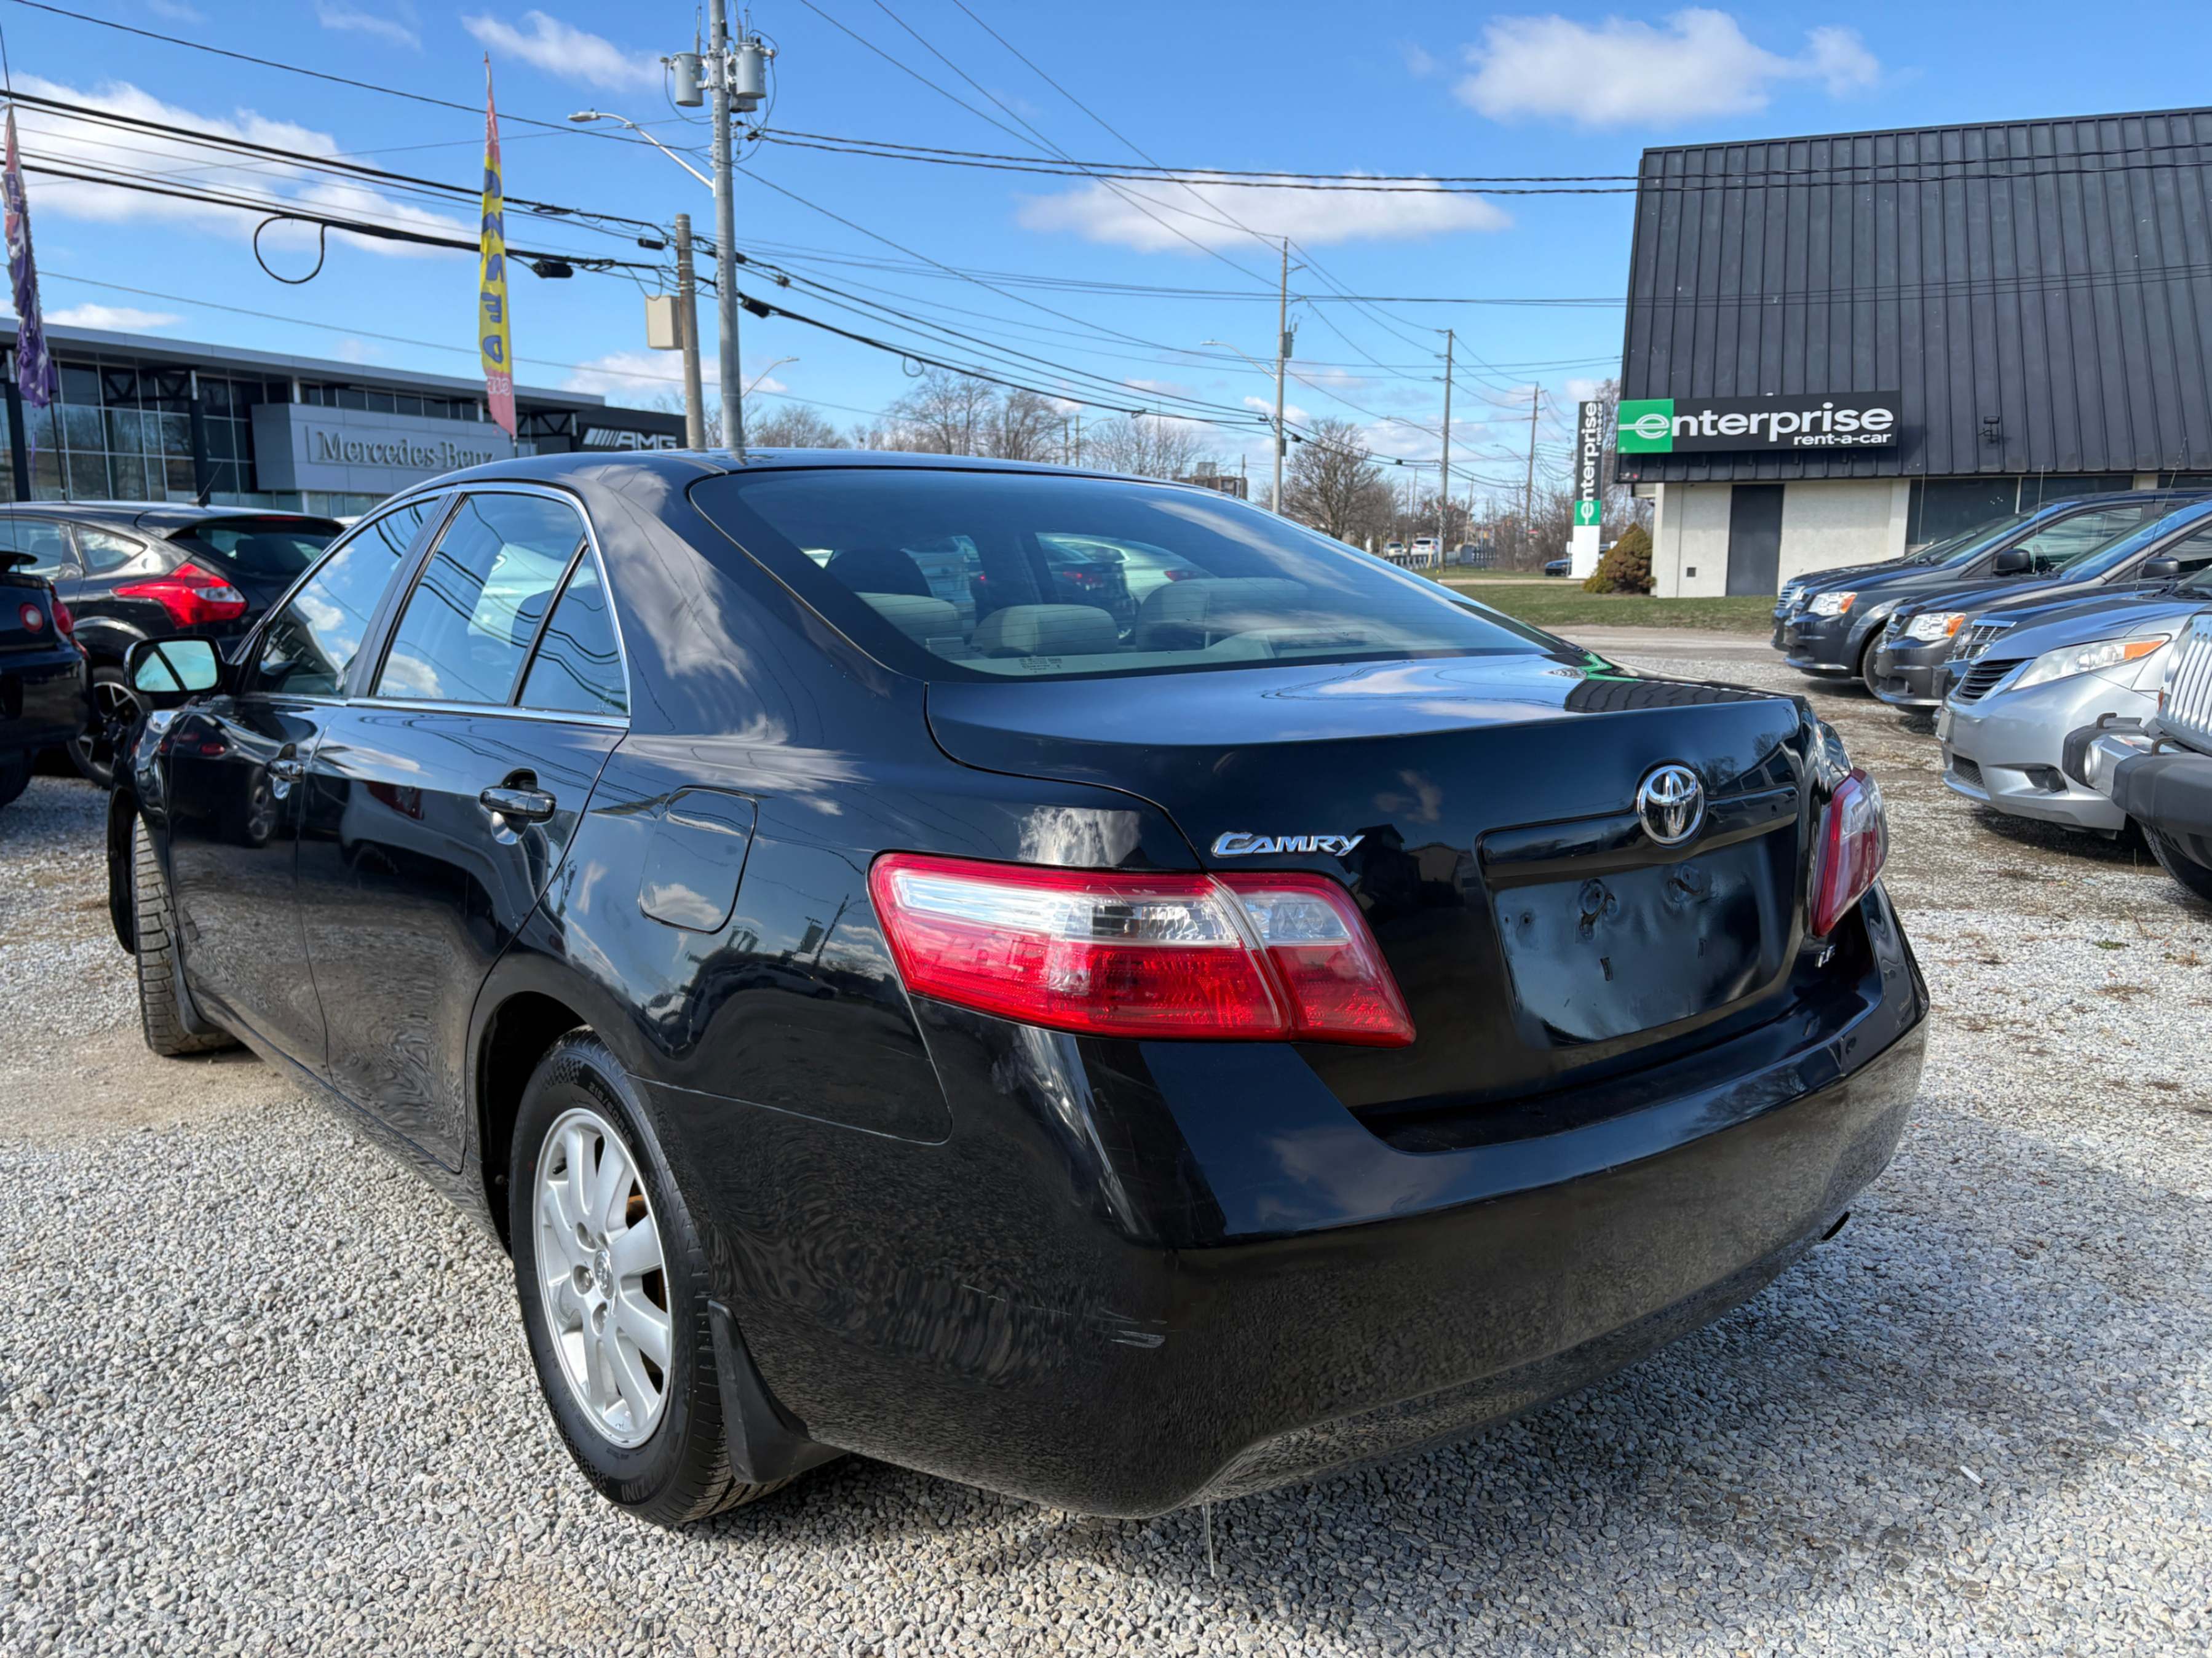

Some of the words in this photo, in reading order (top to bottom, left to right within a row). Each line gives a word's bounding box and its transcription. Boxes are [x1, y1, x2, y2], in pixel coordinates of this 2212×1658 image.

[1618, 402, 1893, 442] enterprise
[315, 430, 494, 468] Mercedes-Benz
[616, 430, 677, 450] AMG
[1793, 432, 1892, 446] rent-a-car
[1580, 402, 1599, 525] enterprise
[1211, 831, 1365, 857] CAMRY
